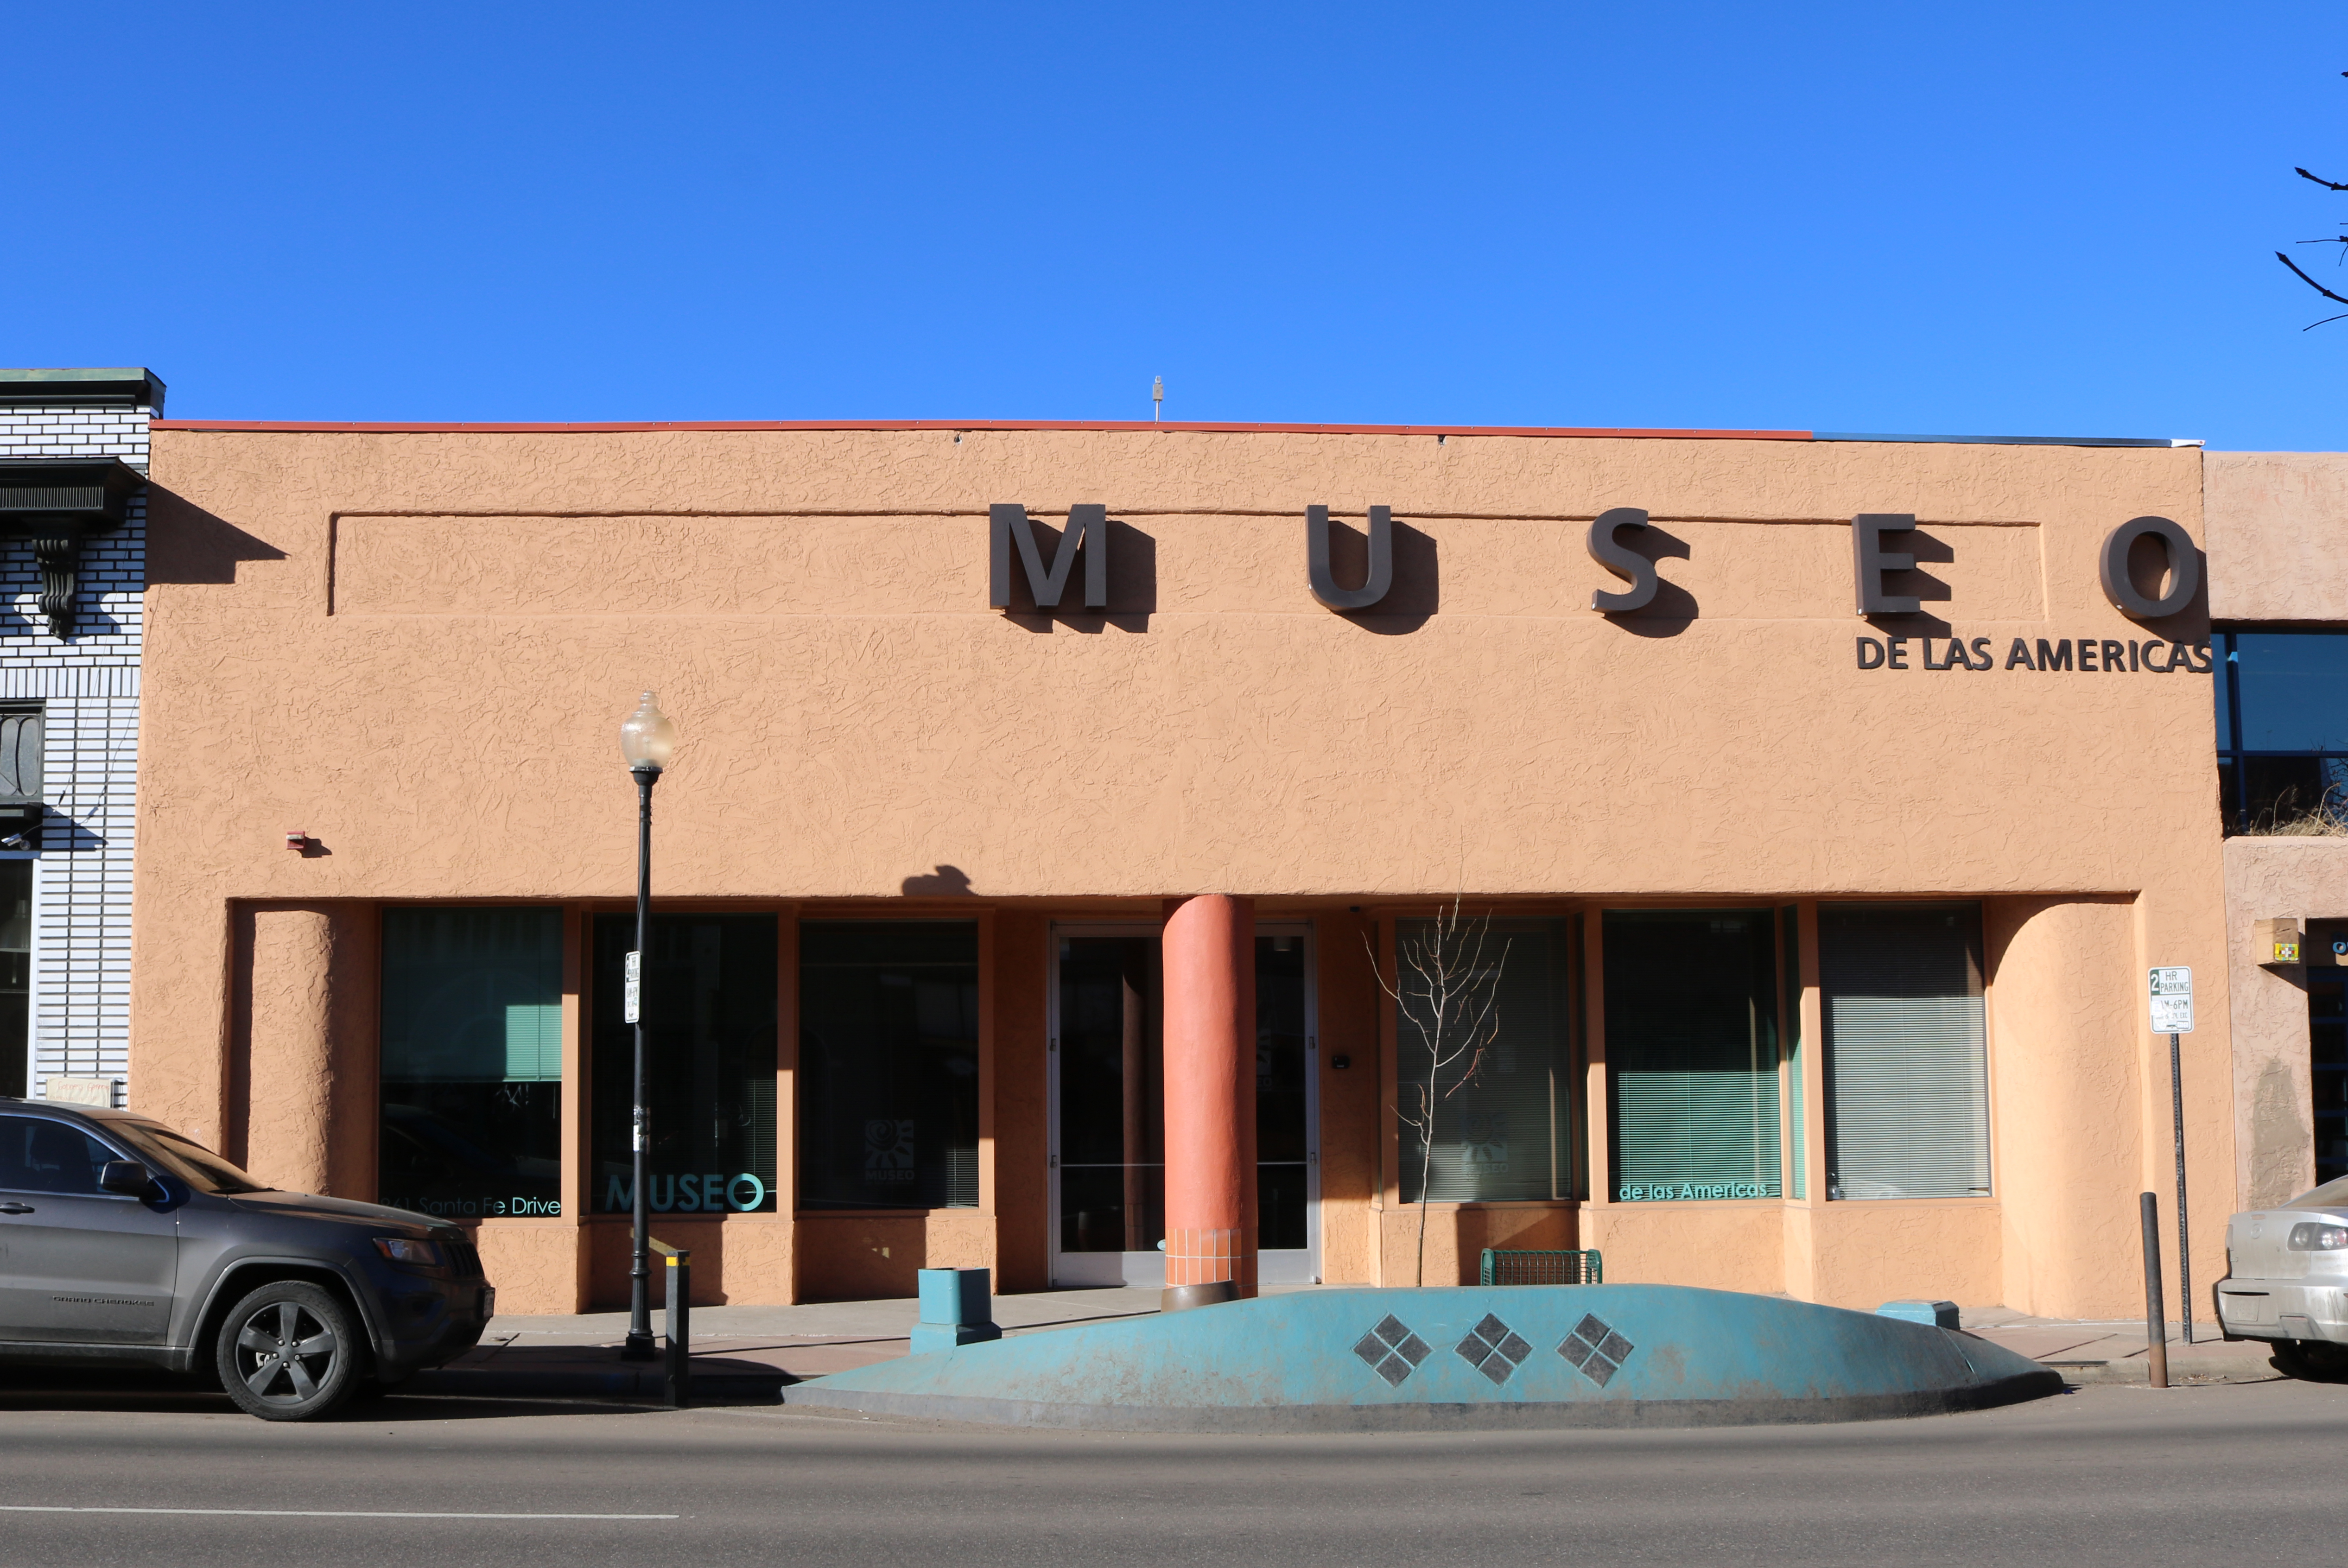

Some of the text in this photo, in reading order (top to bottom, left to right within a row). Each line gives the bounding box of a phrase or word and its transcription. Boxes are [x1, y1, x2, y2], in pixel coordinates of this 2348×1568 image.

[989, 503, 2199, 619] MUSEO
[1855, 636, 2214, 673] DE LAS AMERICAS
[2151, 973, 2159, 991] 2
[2165, 971, 2177, 981] HR
[2160, 981, 2189, 992] PARKING
[865, 1169, 915, 1181] MUSEO
[605, 1172, 765, 1213] MUSEO
[1619, 1181, 1768, 1200] de las Americas
[418, 1196, 476, 1214] Santa
[483, 1196, 506, 1214] Fe
[512, 1196, 561, 1214] Drive
[93, 1298, 154, 1307] CHEROKEE
